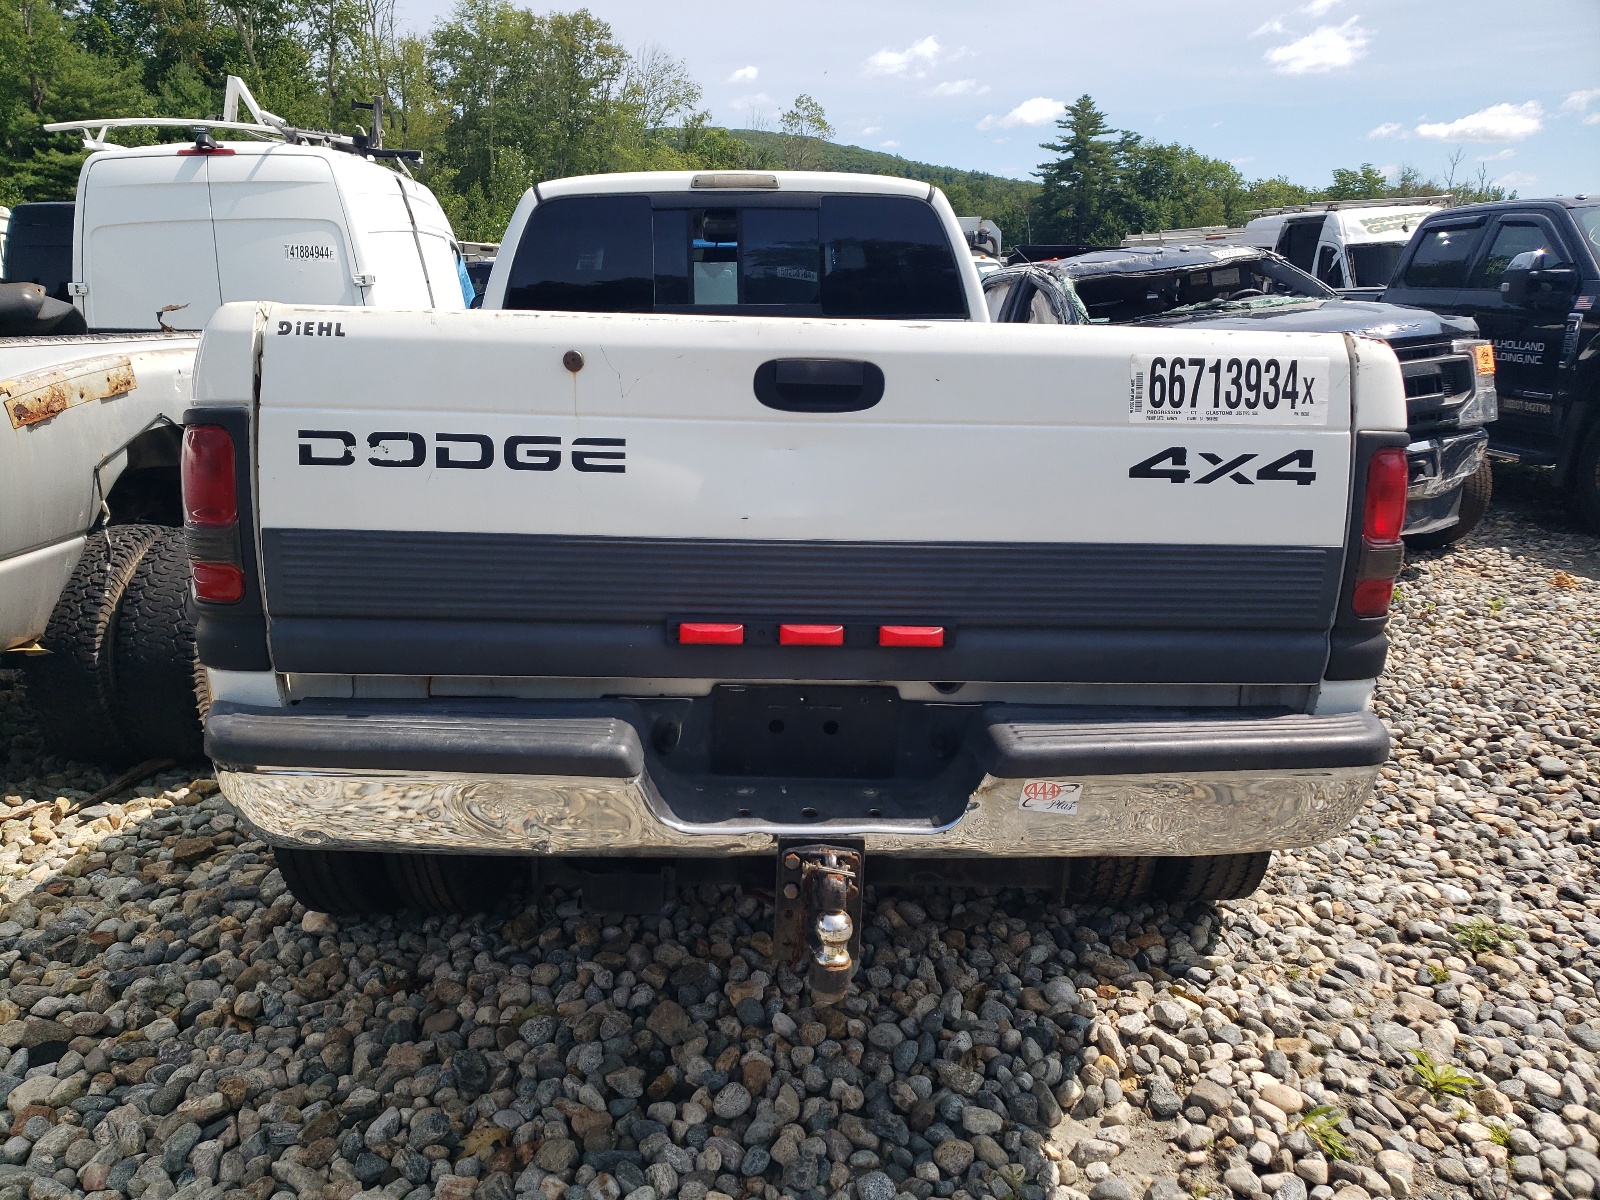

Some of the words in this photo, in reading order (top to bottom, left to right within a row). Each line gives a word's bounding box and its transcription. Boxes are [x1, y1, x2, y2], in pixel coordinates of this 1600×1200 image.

[297, 429, 627, 474] DODGE
[1024, 782, 1061, 801] AAA
[1046, 799, 1076, 811] Plus
